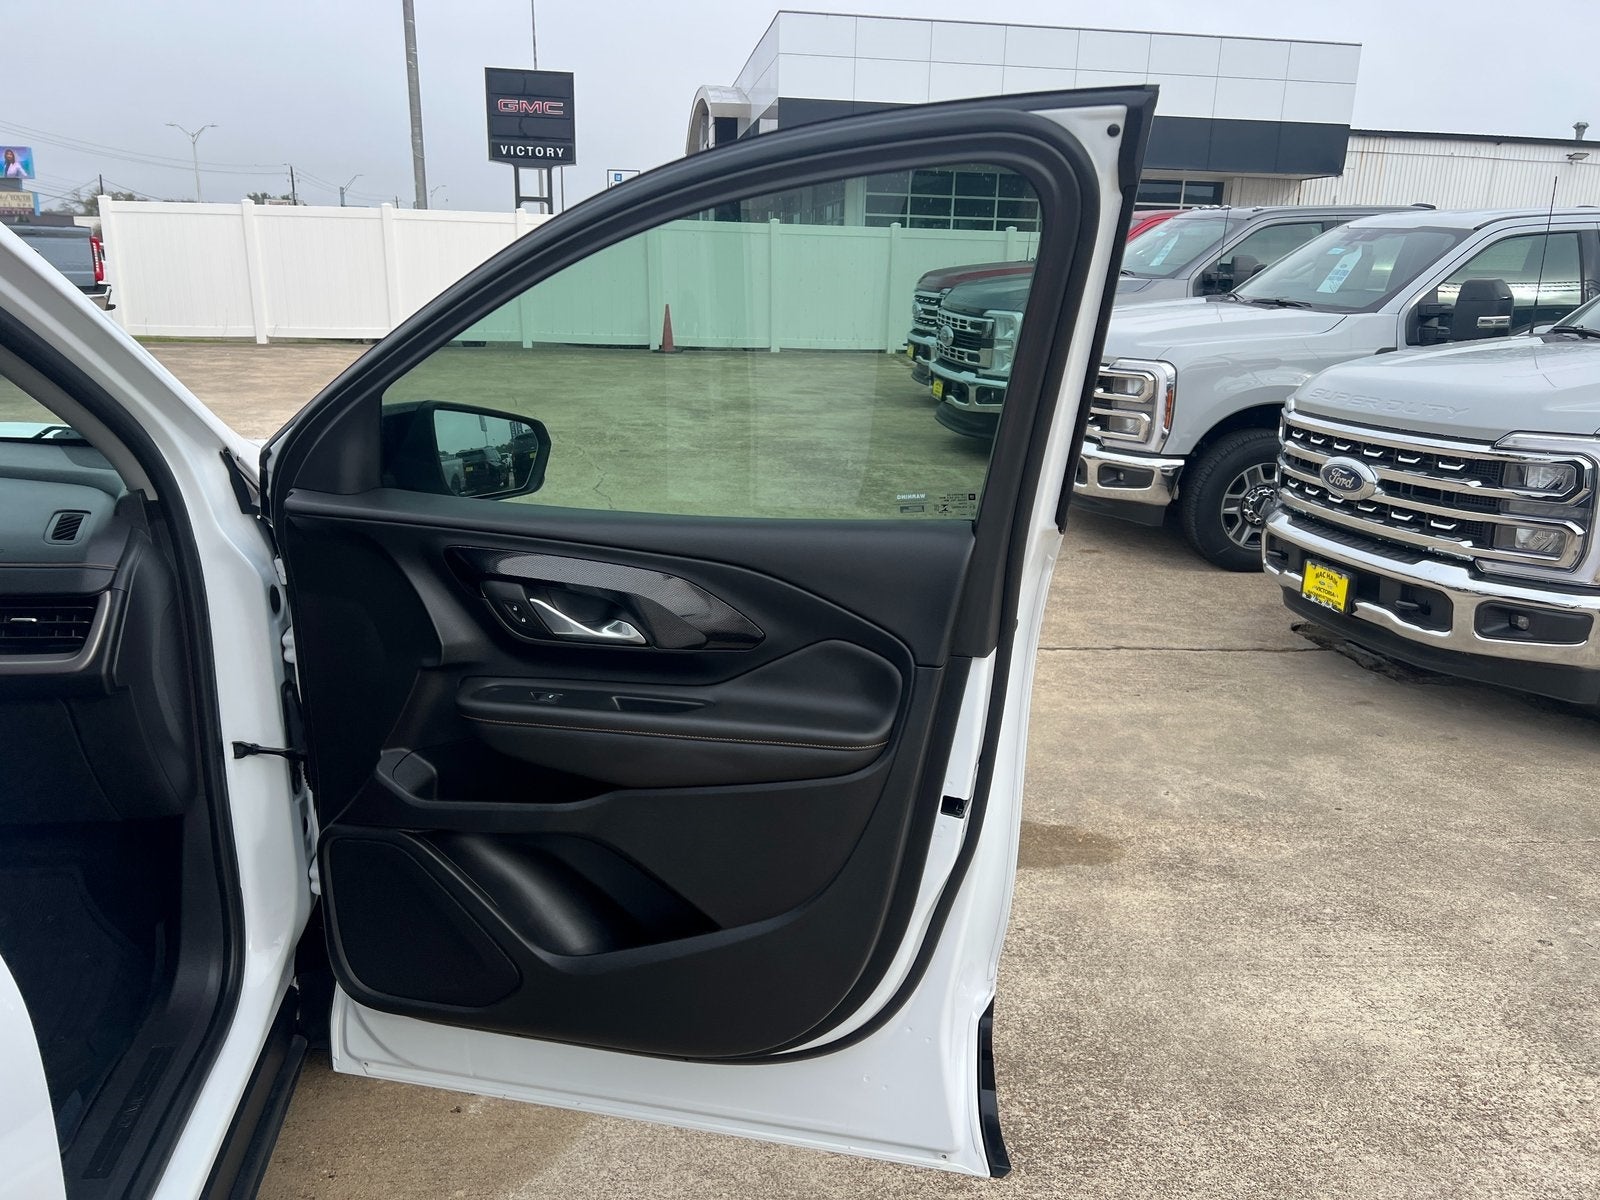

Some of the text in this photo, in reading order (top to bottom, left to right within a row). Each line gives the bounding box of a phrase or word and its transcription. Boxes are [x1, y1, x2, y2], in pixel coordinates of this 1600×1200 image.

[497, 98, 565, 115] GMC
[500, 145, 565, 158] VICTORY
[1309, 387, 1470, 419] SUPER DUTY
[1328, 467, 1355, 489] Ford
[1315, 571, 1326, 579] MAC
